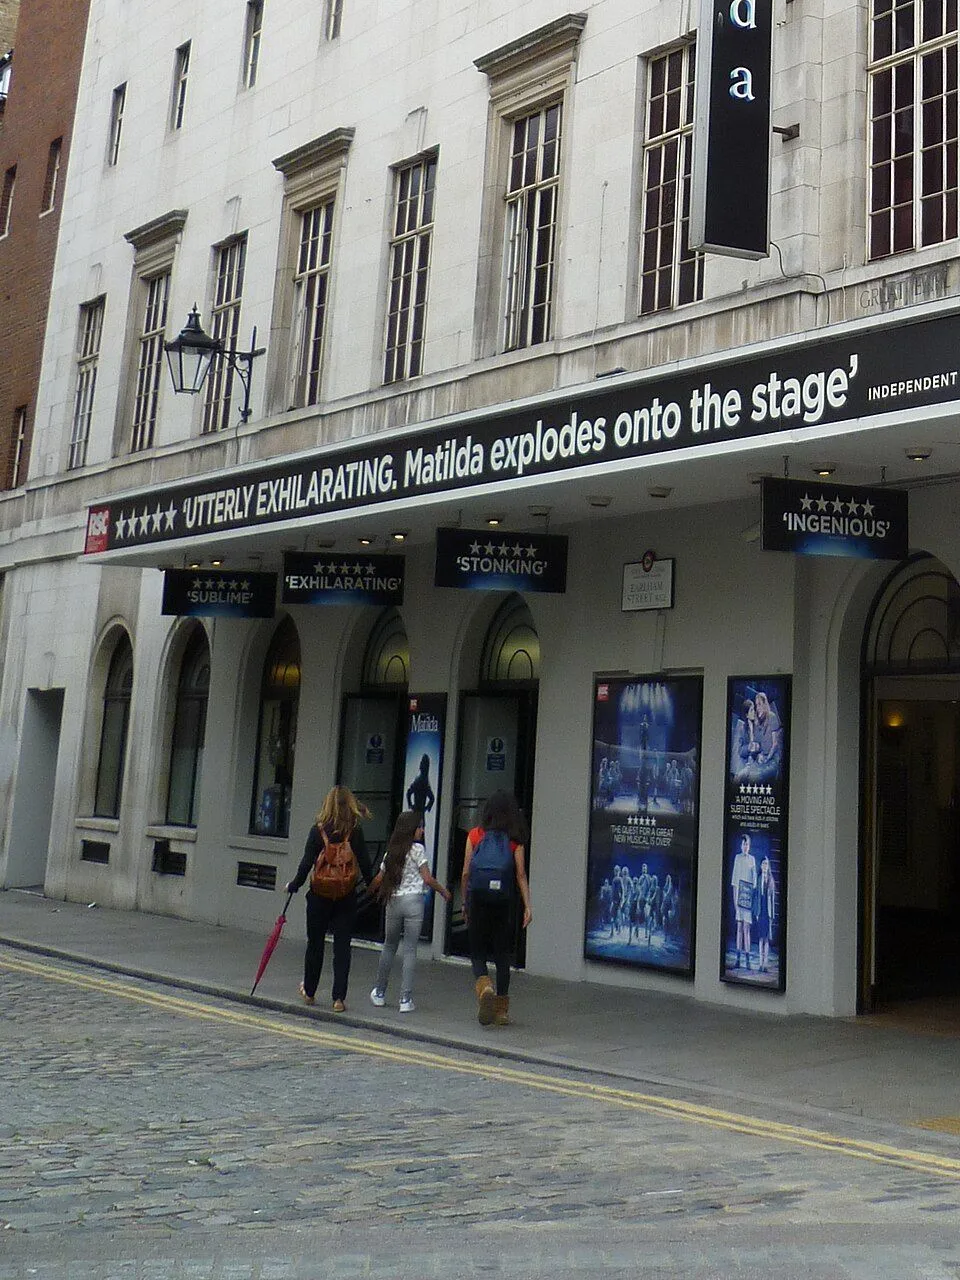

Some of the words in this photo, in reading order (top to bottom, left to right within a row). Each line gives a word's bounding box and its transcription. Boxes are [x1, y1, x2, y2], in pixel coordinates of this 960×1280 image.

[868, 371, 958, 401] INDEPENDENT
[182, 485, 254, 529] 'UTTERLY
[256, 455, 397, 515] EXHILARATING.
[403, 435, 484, 488] Matilda
[489, 415, 606, 476] explodes
[614, 396, 681, 446] onto
[689, 383, 741, 433] the
[751, 354, 859, 422] stage'
[783, 512, 890, 538] 'INGENIOUS'
[456, 555, 548, 576] 'STONKING'
[285, 575, 401, 592] 'EXHILARATING'
[187, 590, 253, 605] 'SUBLIME'
[412, 715, 439, 733] Matilda
